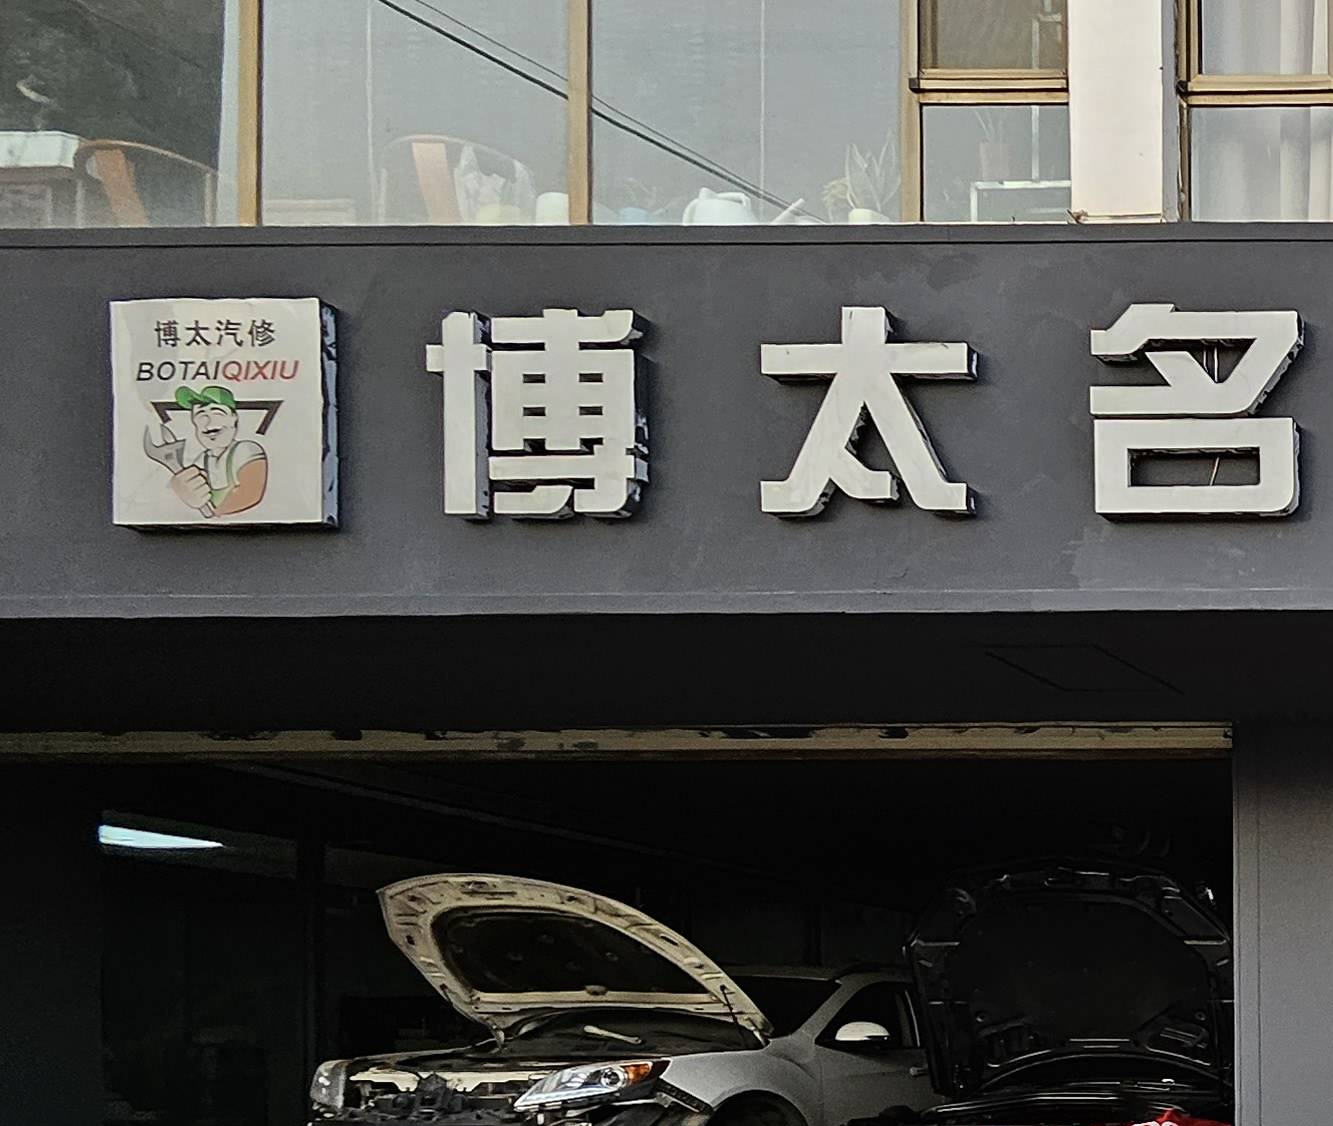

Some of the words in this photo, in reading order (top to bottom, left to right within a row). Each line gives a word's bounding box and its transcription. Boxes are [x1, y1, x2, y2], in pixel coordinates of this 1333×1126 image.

[154, 319, 276, 348] 博太汽修
[136, 360, 299, 382] BOTAIQIXIU
